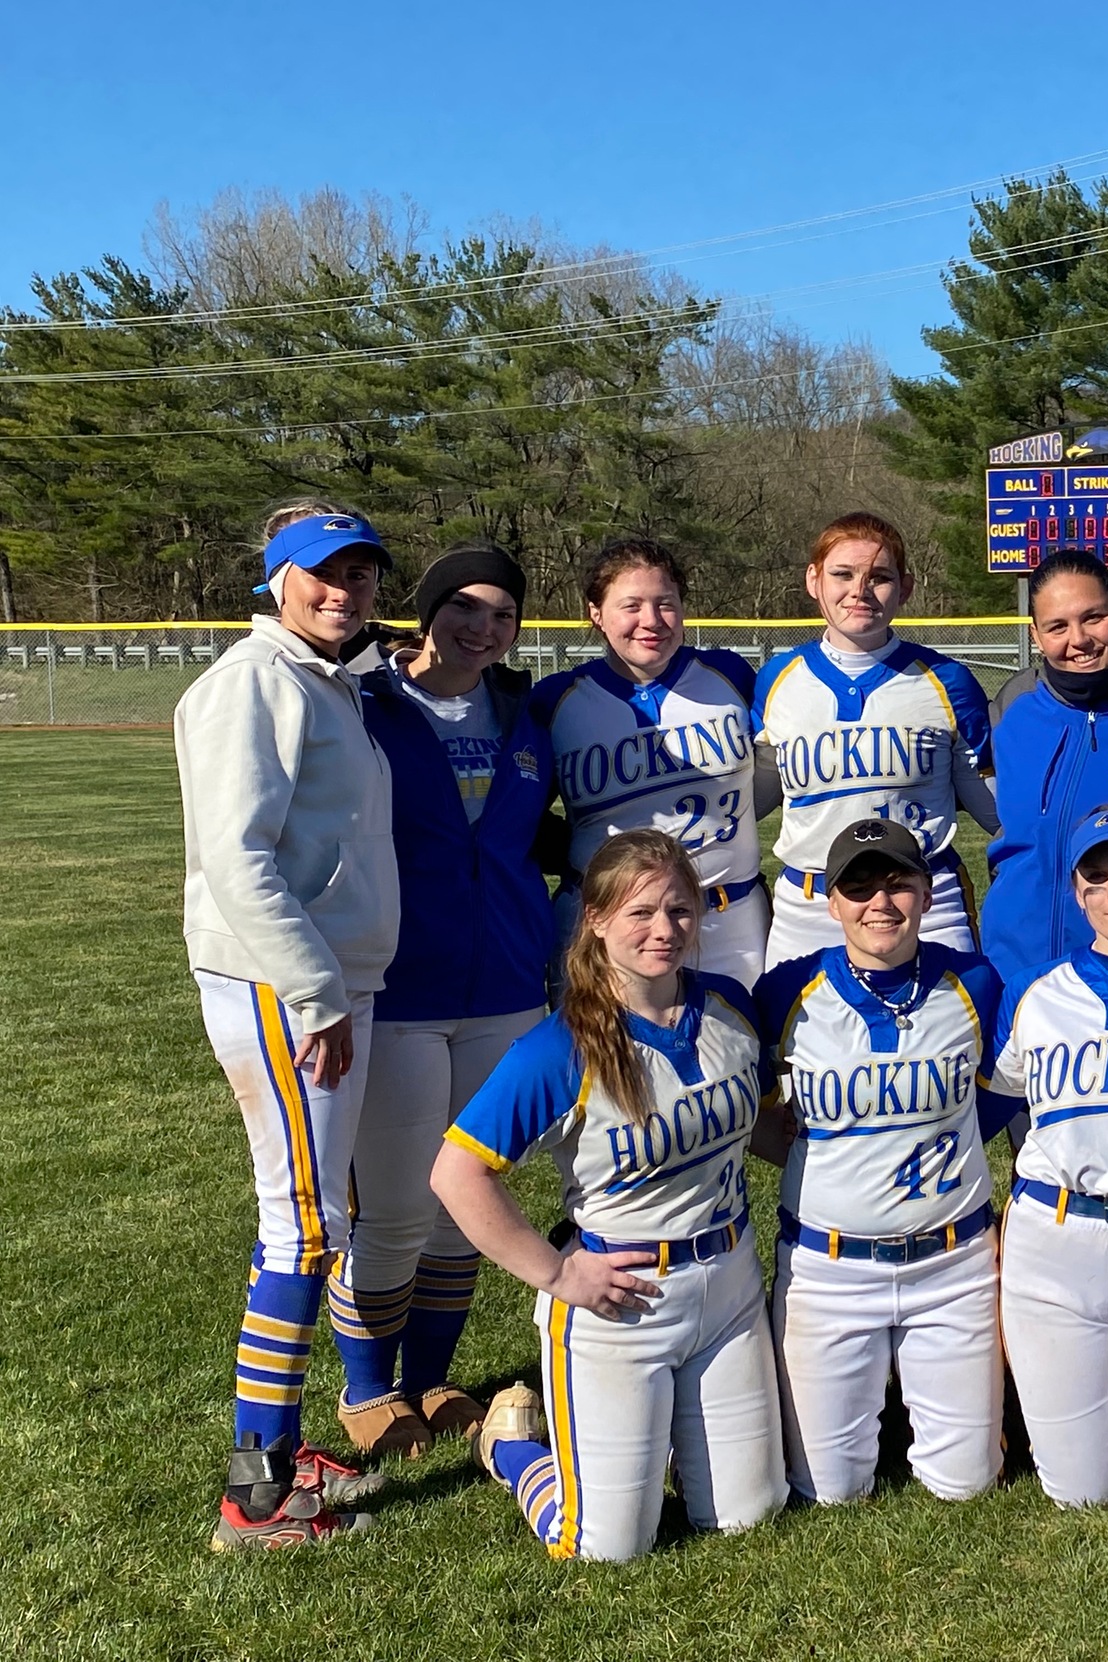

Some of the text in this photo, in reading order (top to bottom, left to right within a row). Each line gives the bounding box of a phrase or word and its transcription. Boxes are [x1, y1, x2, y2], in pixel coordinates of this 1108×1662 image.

[989, 432, 1063, 464] HOCKING
[1005, 479, 1037, 492] BALL
[1031, 505, 1036, 516] 1
[1049, 505, 1055, 516] 2
[1068, 504, 1075, 515] 3
[1087, 504, 1093, 514] 4
[990, 523, 1026, 537] GUEST
[991, 550, 1026, 563] HOME
[559, 711, 749, 801] HOCKING
[777, 724, 942, 791] HOCKING
[674, 789, 741, 849] 23
[873, 801, 934, 856] 3
[799, 1052, 972, 1122] HOCKING
[605, 1062, 760, 1174] HOCKIN
[893, 1130, 963, 1201] 42
